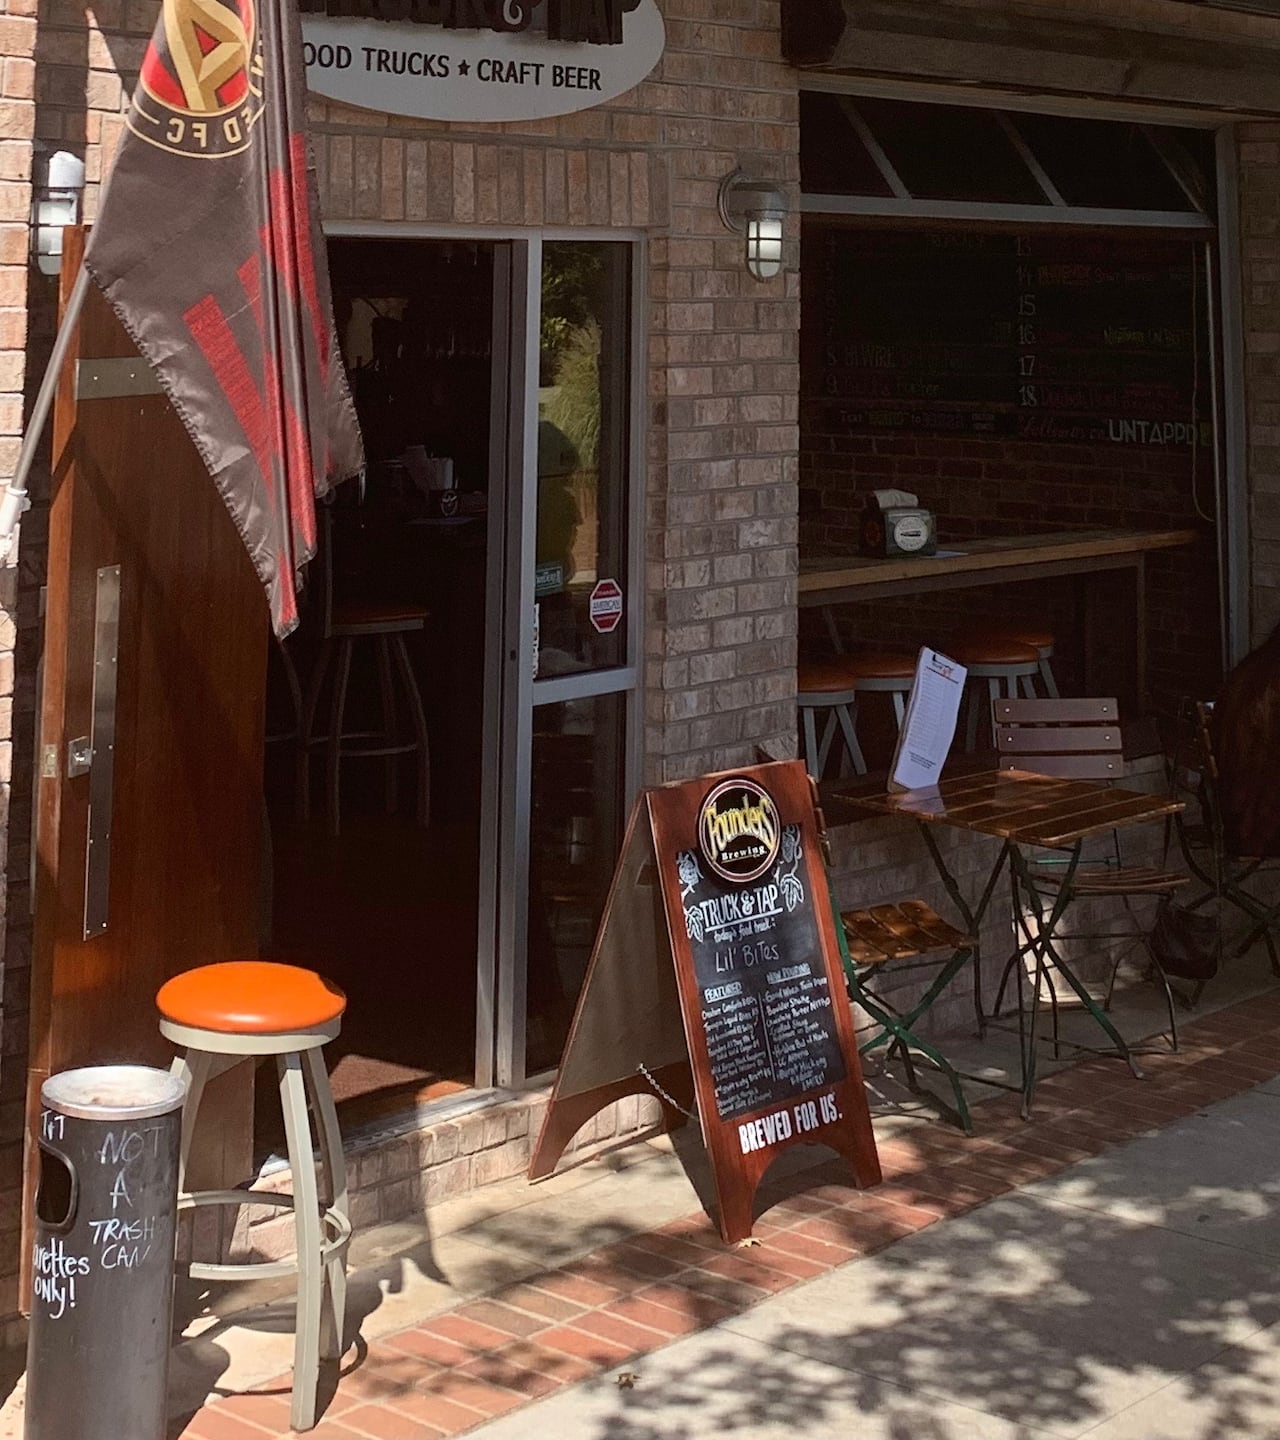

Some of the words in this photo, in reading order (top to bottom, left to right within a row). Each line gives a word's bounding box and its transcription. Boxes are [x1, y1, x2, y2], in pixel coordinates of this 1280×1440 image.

[303, 42, 352, 69] OOD
[362, 47, 450, 77] TRUCKS
[477, 59, 545, 86] CRAFT
[552, 64, 602, 90] BEER
[721, 845, 766, 861] Brewing
[699, 892, 743, 927] TRUCK
[754, 884, 778, 914] TAP
[100, 1126, 164, 1164] NOT
[738, 1114, 792, 1155] BREWED
[795, 1104, 819, 1134] FOR
[110, 1166, 133, 1209] A
[89, 1216, 155, 1245] TRASH
[101, 1244, 151, 1269] CAN
